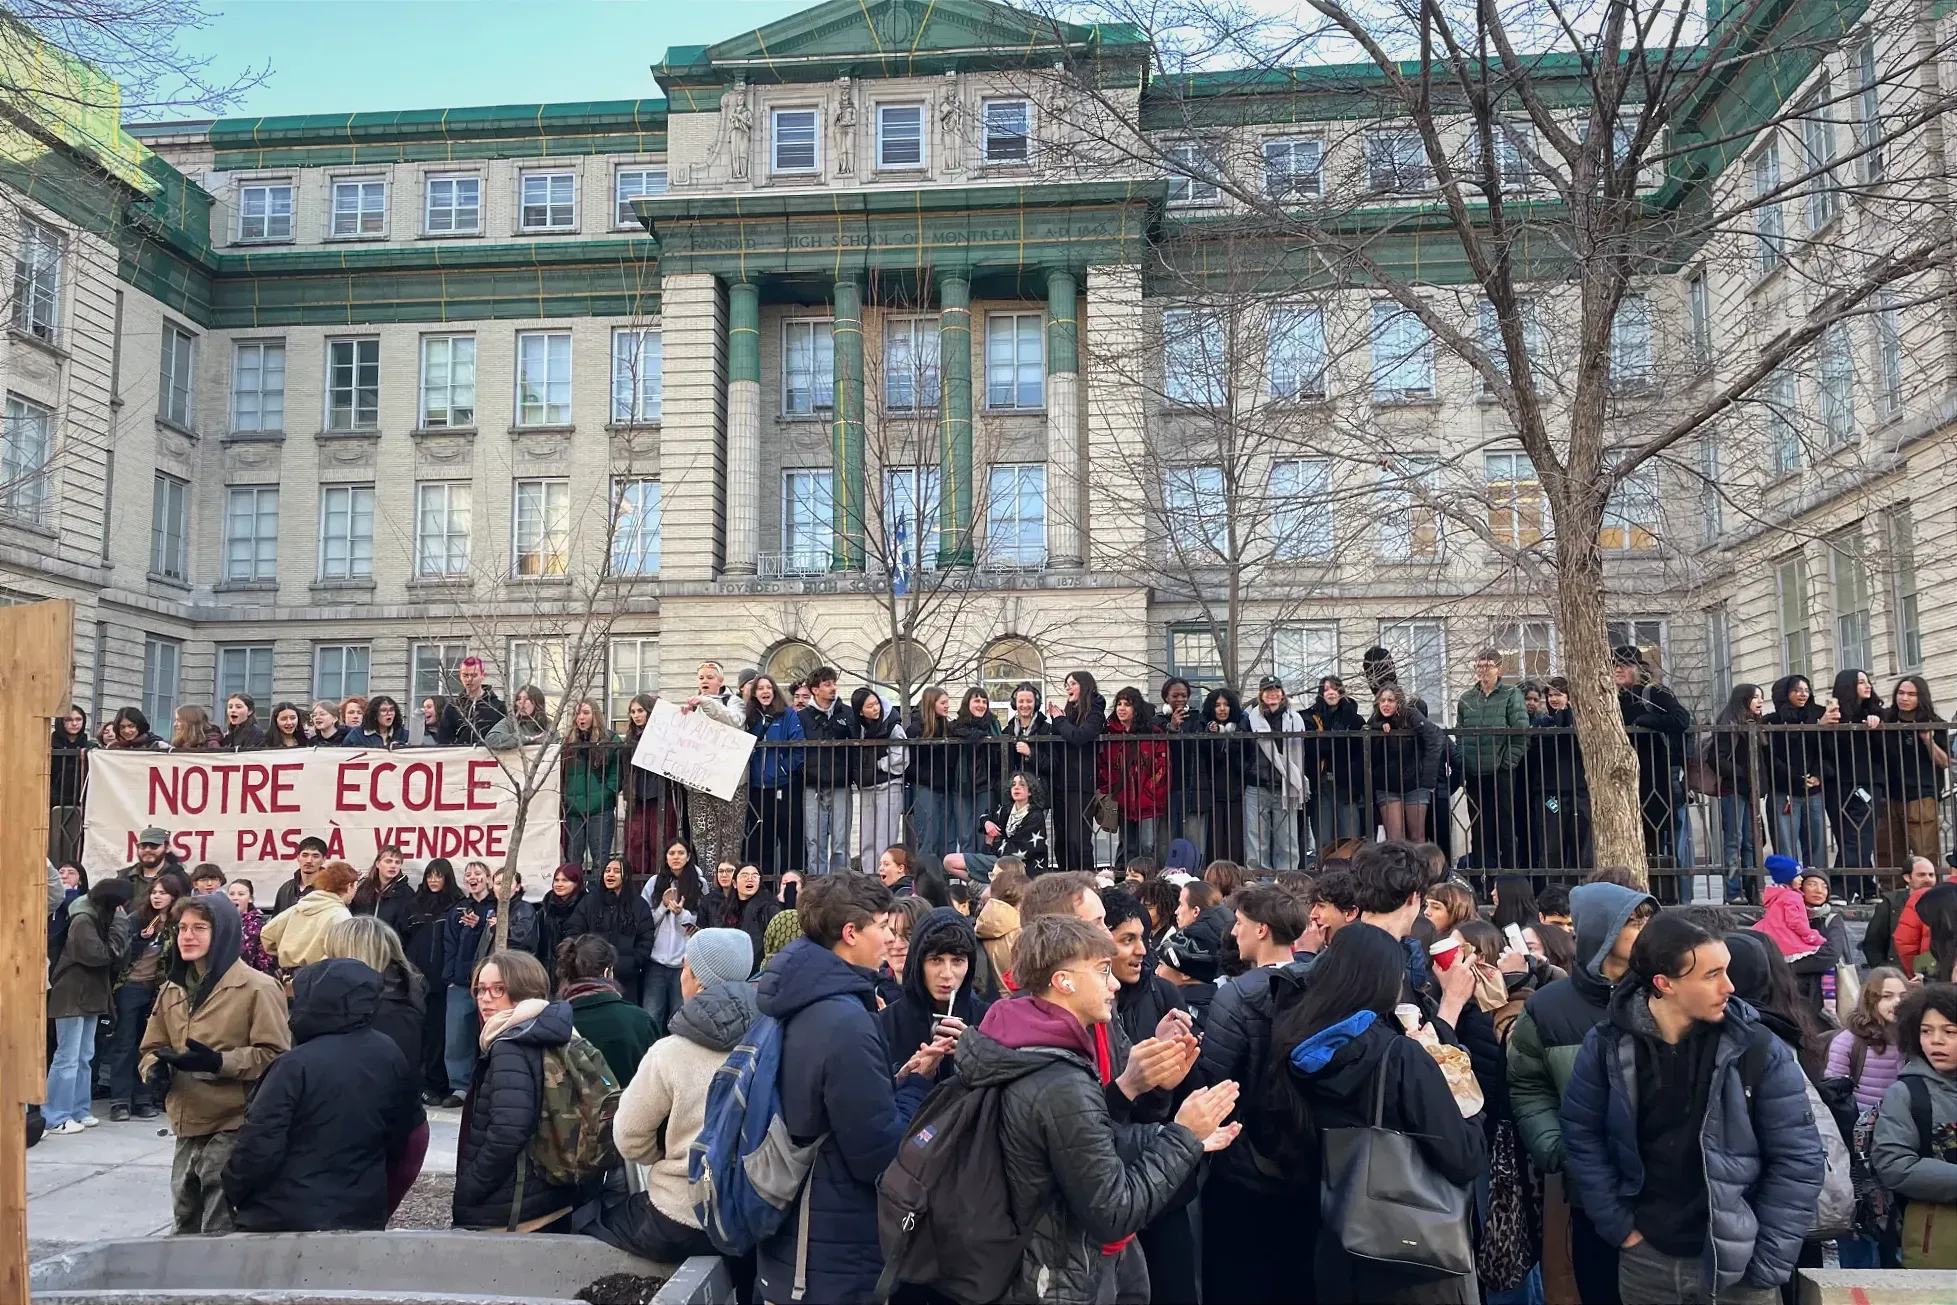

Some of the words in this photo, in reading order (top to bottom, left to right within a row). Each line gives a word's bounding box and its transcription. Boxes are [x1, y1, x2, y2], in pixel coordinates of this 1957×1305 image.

[783, 236, 822, 248] HIGH
[831, 233, 893, 247] SCHOOL
[933, 230, 1018, 243] MONTREAL
[803, 581, 838, 593] HIGH
[1056, 577, 1082, 587] 1875
[149, 764, 304, 815] NOTRE
[336, 751, 499, 812] ÉCOLE
[238, 829, 302, 861] PAS
[326, 819, 346, 860] À
[374, 825, 508, 859] VENDRE
